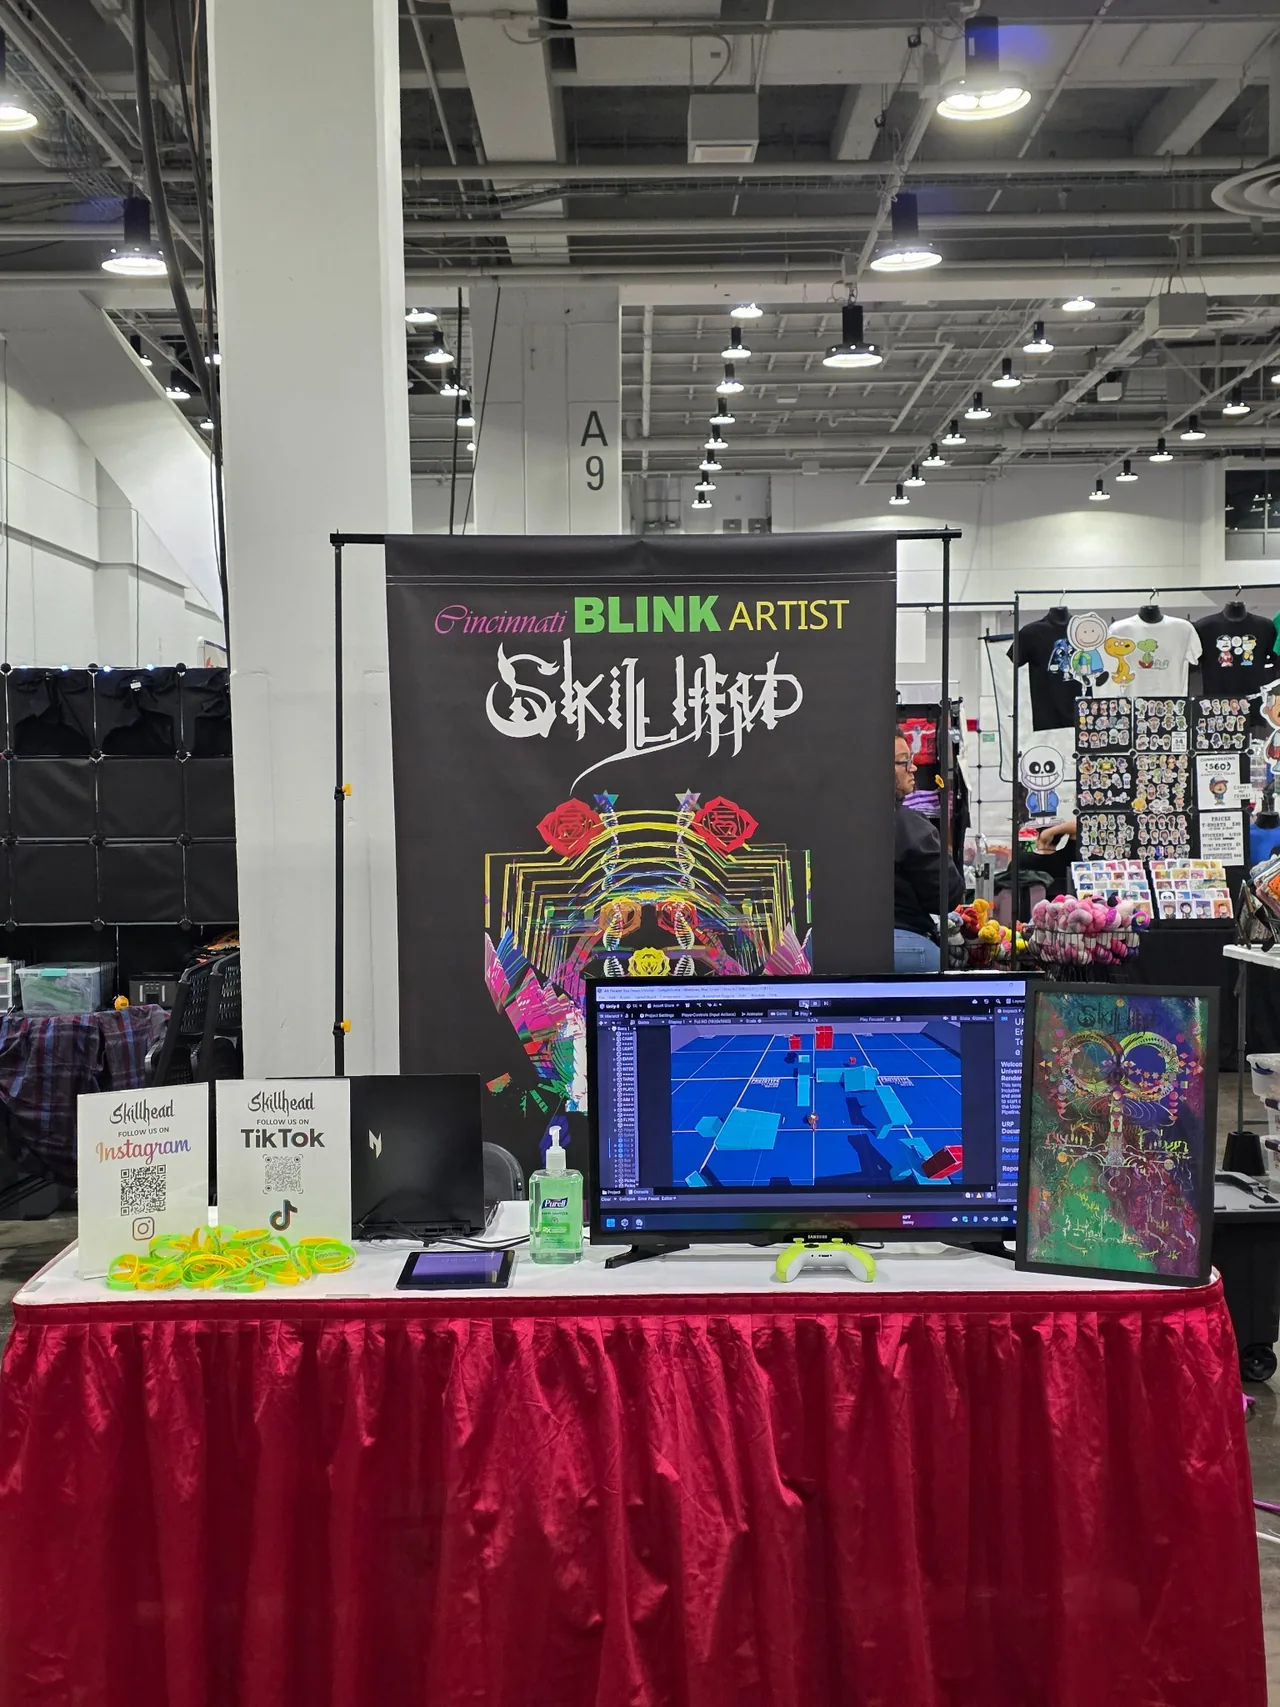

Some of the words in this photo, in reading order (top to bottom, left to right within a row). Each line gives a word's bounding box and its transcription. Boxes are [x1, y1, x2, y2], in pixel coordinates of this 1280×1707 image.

[580, 410, 609, 447] A
[585, 455, 605, 491] 9
[434, 604, 569, 635] Cincinnati
[573, 595, 722, 634] BLINK
[729, 599, 850, 631] ARTIST
[118, 1130, 146, 1138] FOLLOW
[240, 1128, 325, 1149] TikTok
[96, 1139, 192, 1165] Instagram
